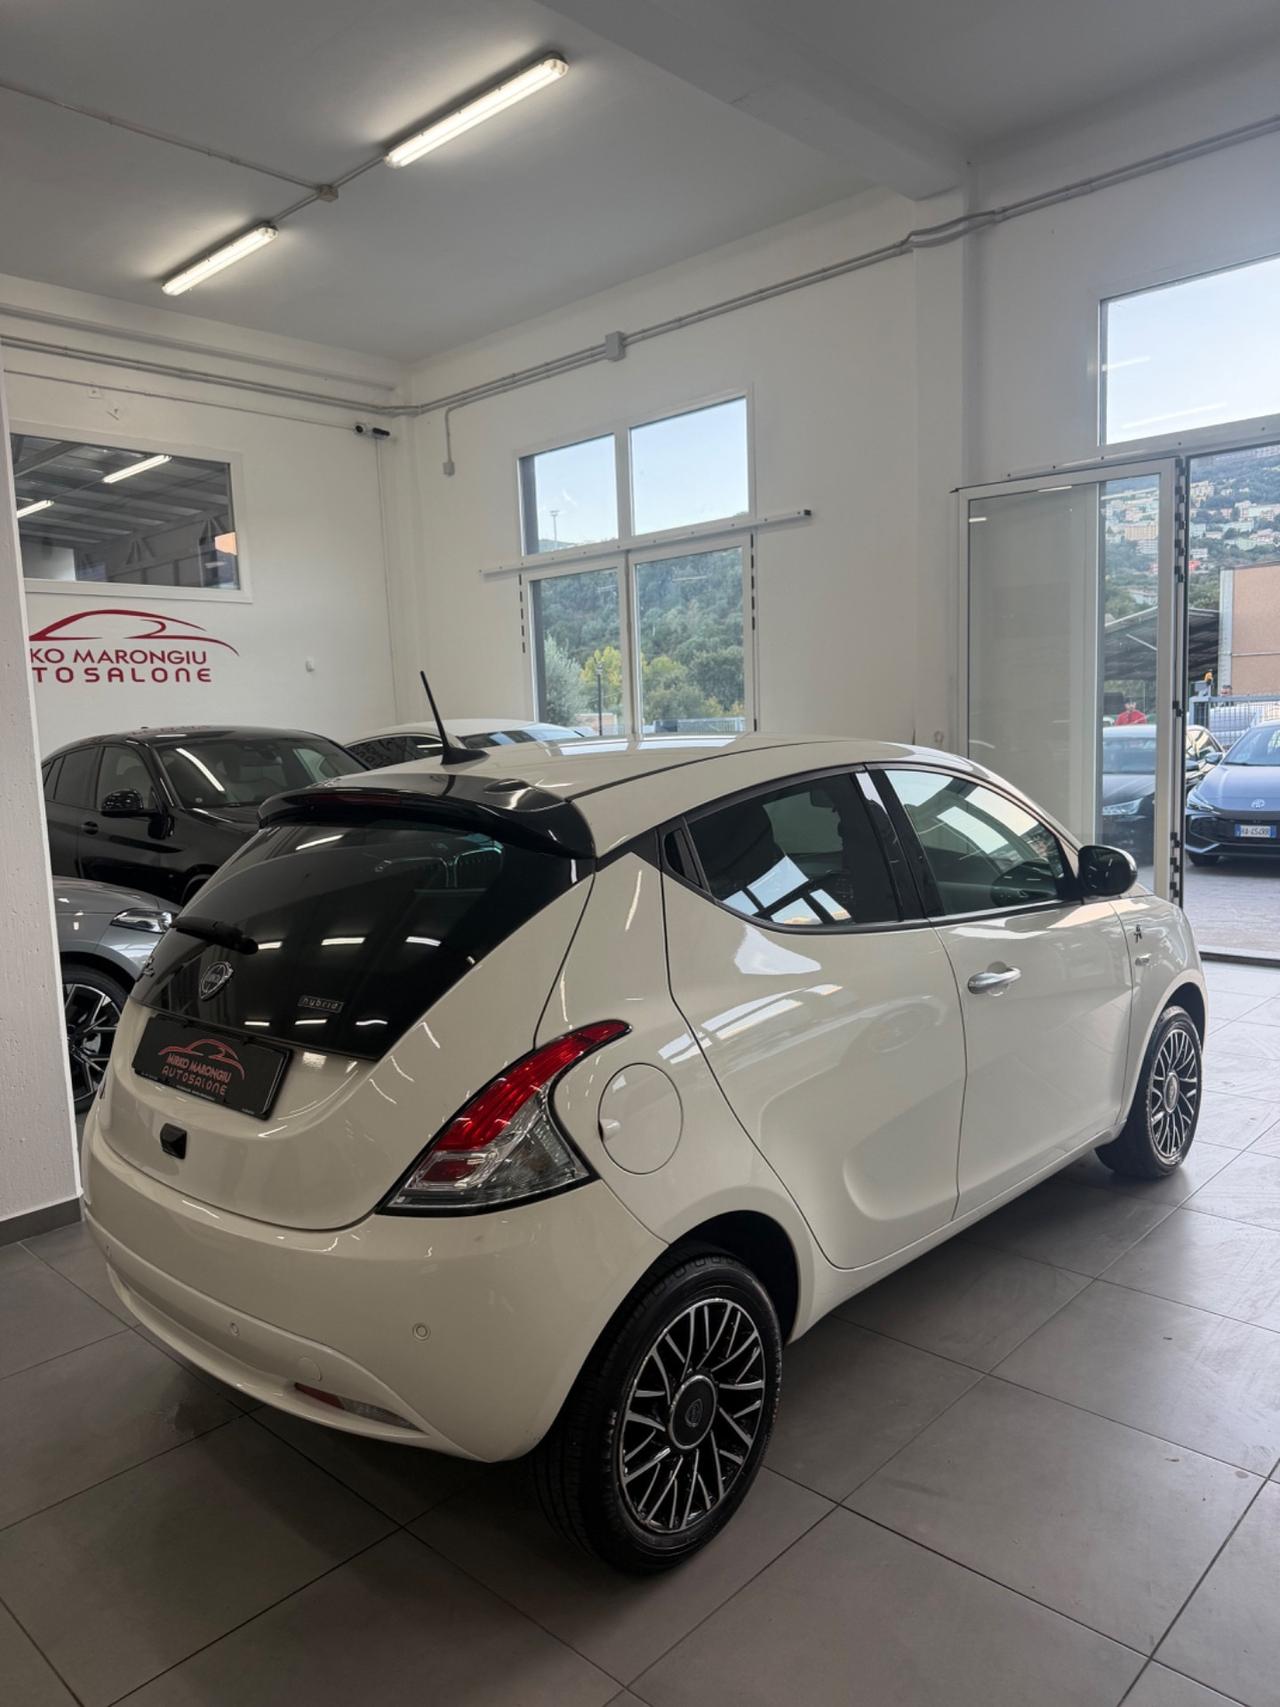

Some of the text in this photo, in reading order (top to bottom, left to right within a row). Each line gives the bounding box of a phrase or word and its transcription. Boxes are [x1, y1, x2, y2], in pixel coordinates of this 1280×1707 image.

[73, 649, 206, 665] MARONGIU
[160, 1065, 228, 1096] AUTOSALONE
[189, 1060, 232, 1084] MARONGIU
